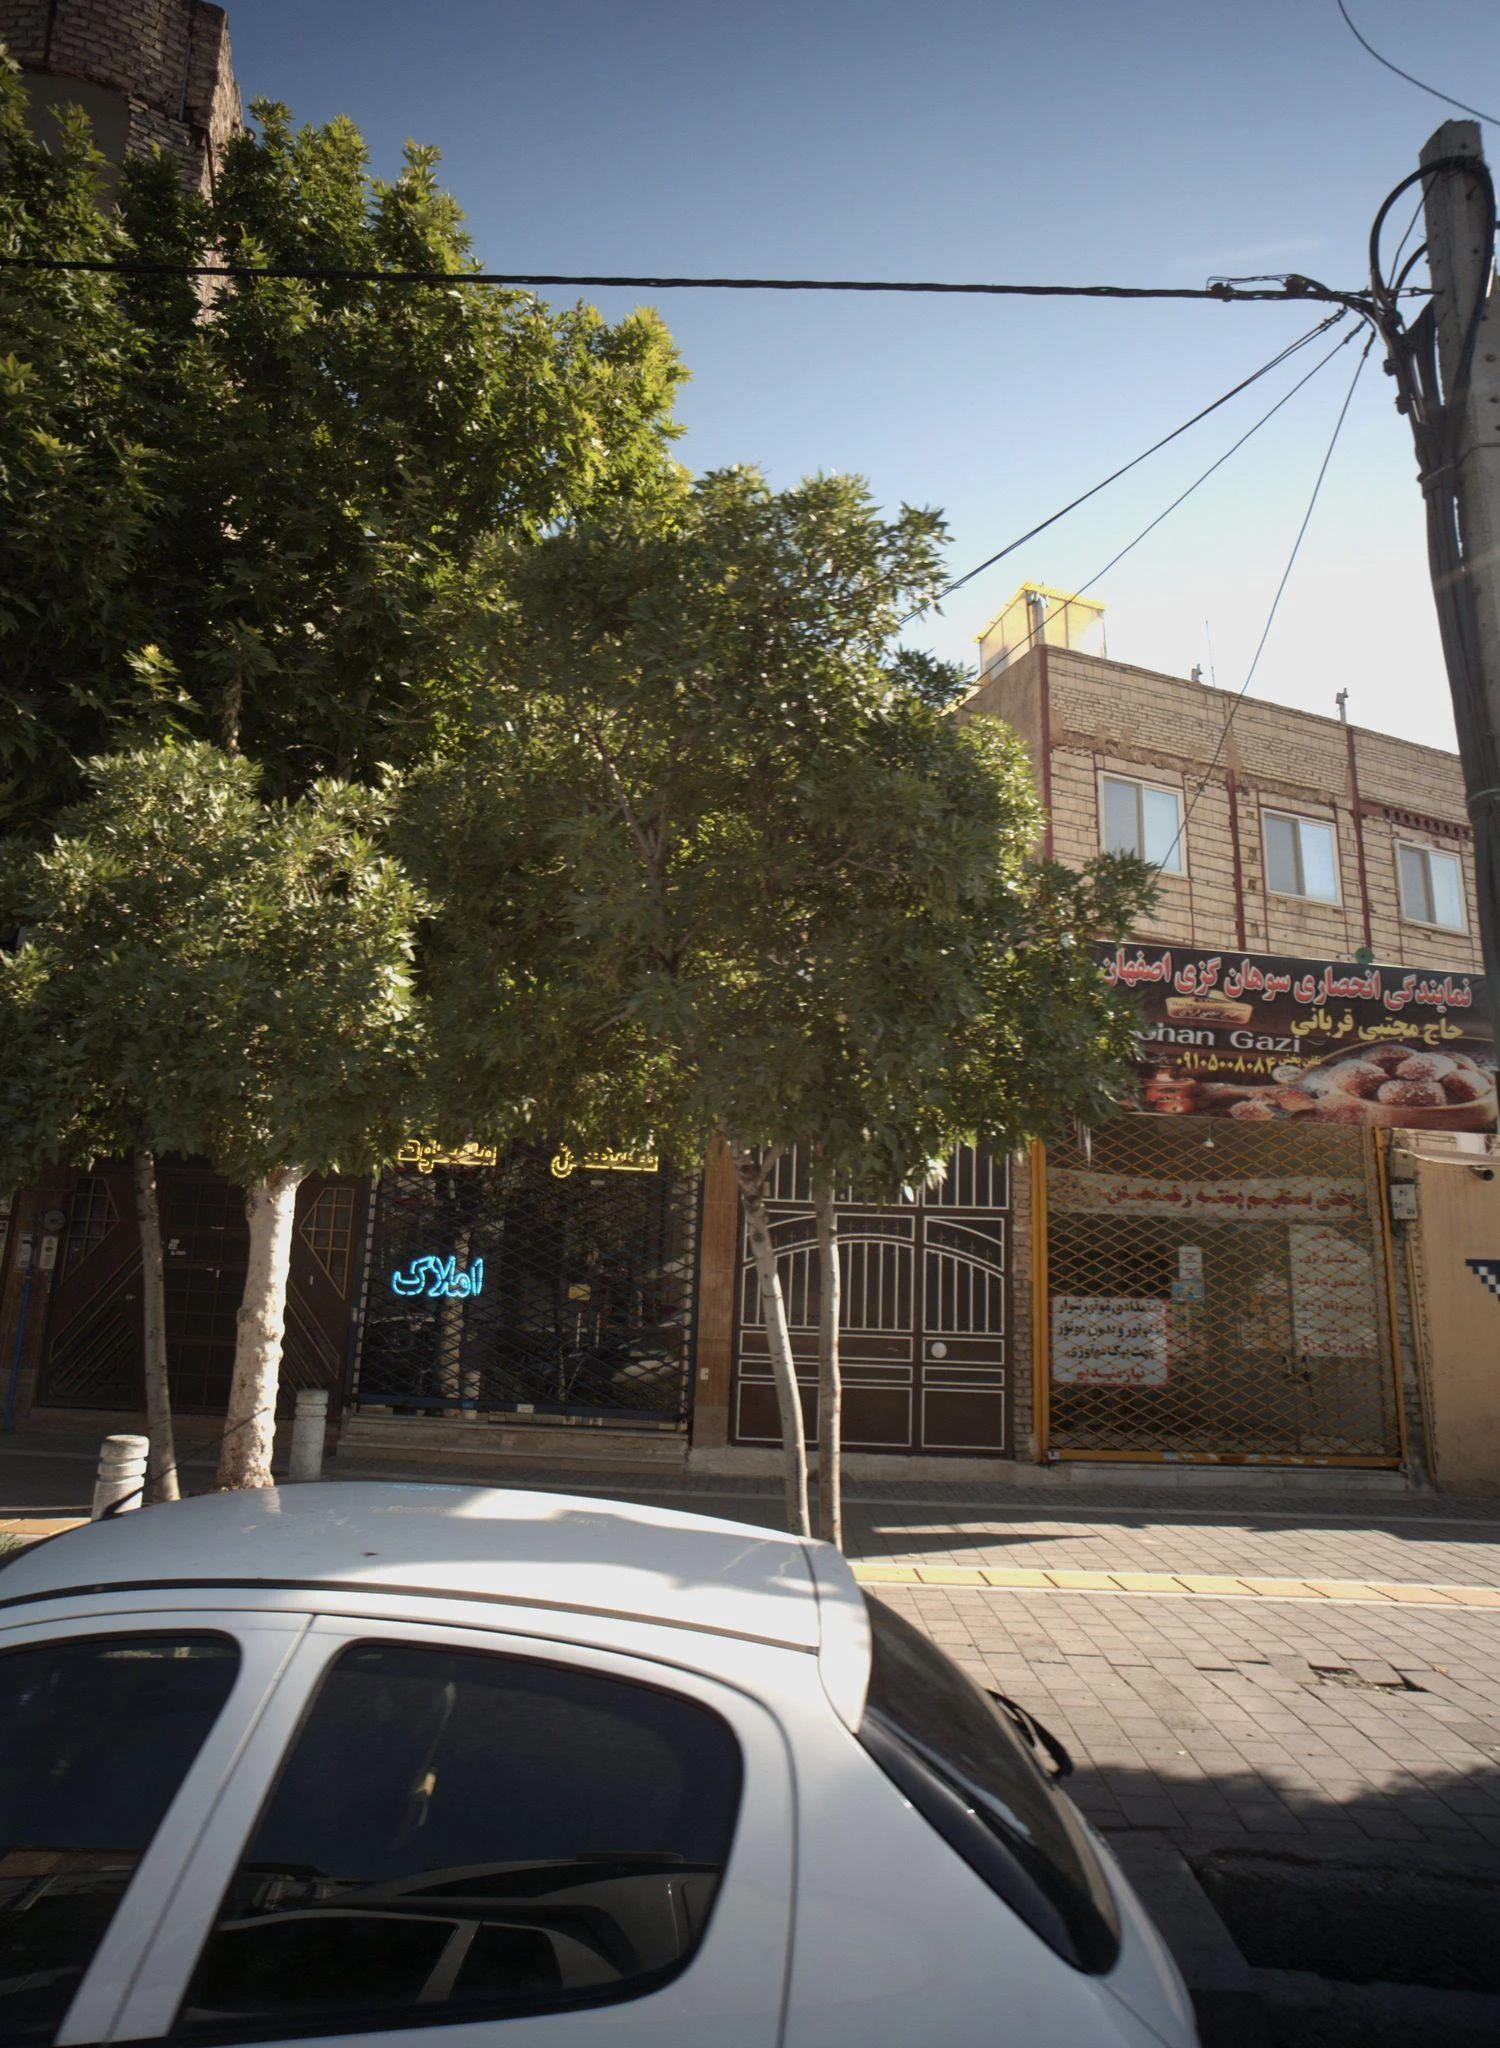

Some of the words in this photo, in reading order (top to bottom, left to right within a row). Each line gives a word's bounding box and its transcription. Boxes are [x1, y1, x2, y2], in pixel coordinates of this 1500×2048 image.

[1102, 947, 1172, 986] اصفهان
[1174, 956, 1222, 995] گزی
[1224, 959, 1291, 1001] سوهان
[1294, 966, 1381, 1005] انحصاری
[1384, 975, 1472, 1013] نمایندگی
[1230, 1030, 1301, 1053] Gazi
[1290, 1008, 1354, 1038] قربانی
[1357, 1015, 1420, 1041] مجتبی
[1423, 1016, 1463, 1045] حاج
[392, 1255, 484, 1298] املاک
